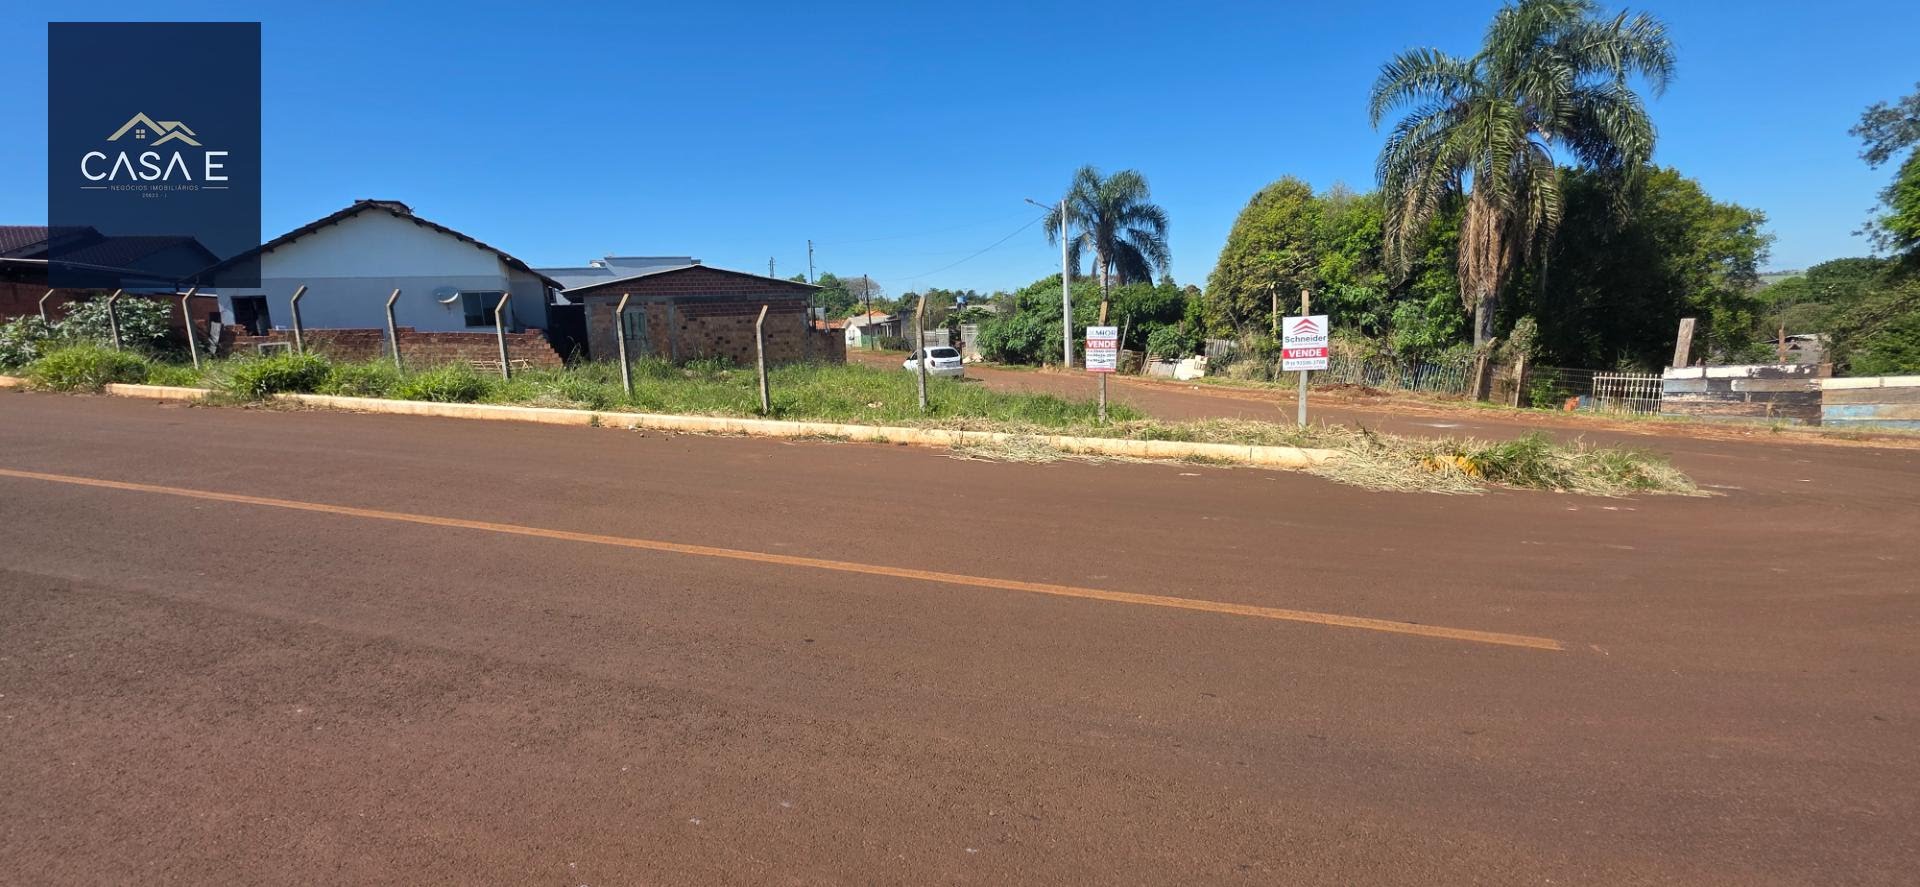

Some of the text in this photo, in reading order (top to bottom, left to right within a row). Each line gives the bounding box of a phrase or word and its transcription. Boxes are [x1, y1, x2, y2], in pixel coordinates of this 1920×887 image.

[1284, 335, 1327, 343] Schneider
[1087, 340, 1116, 348] VENDE
[1289, 348, 1322, 357] VENDE
